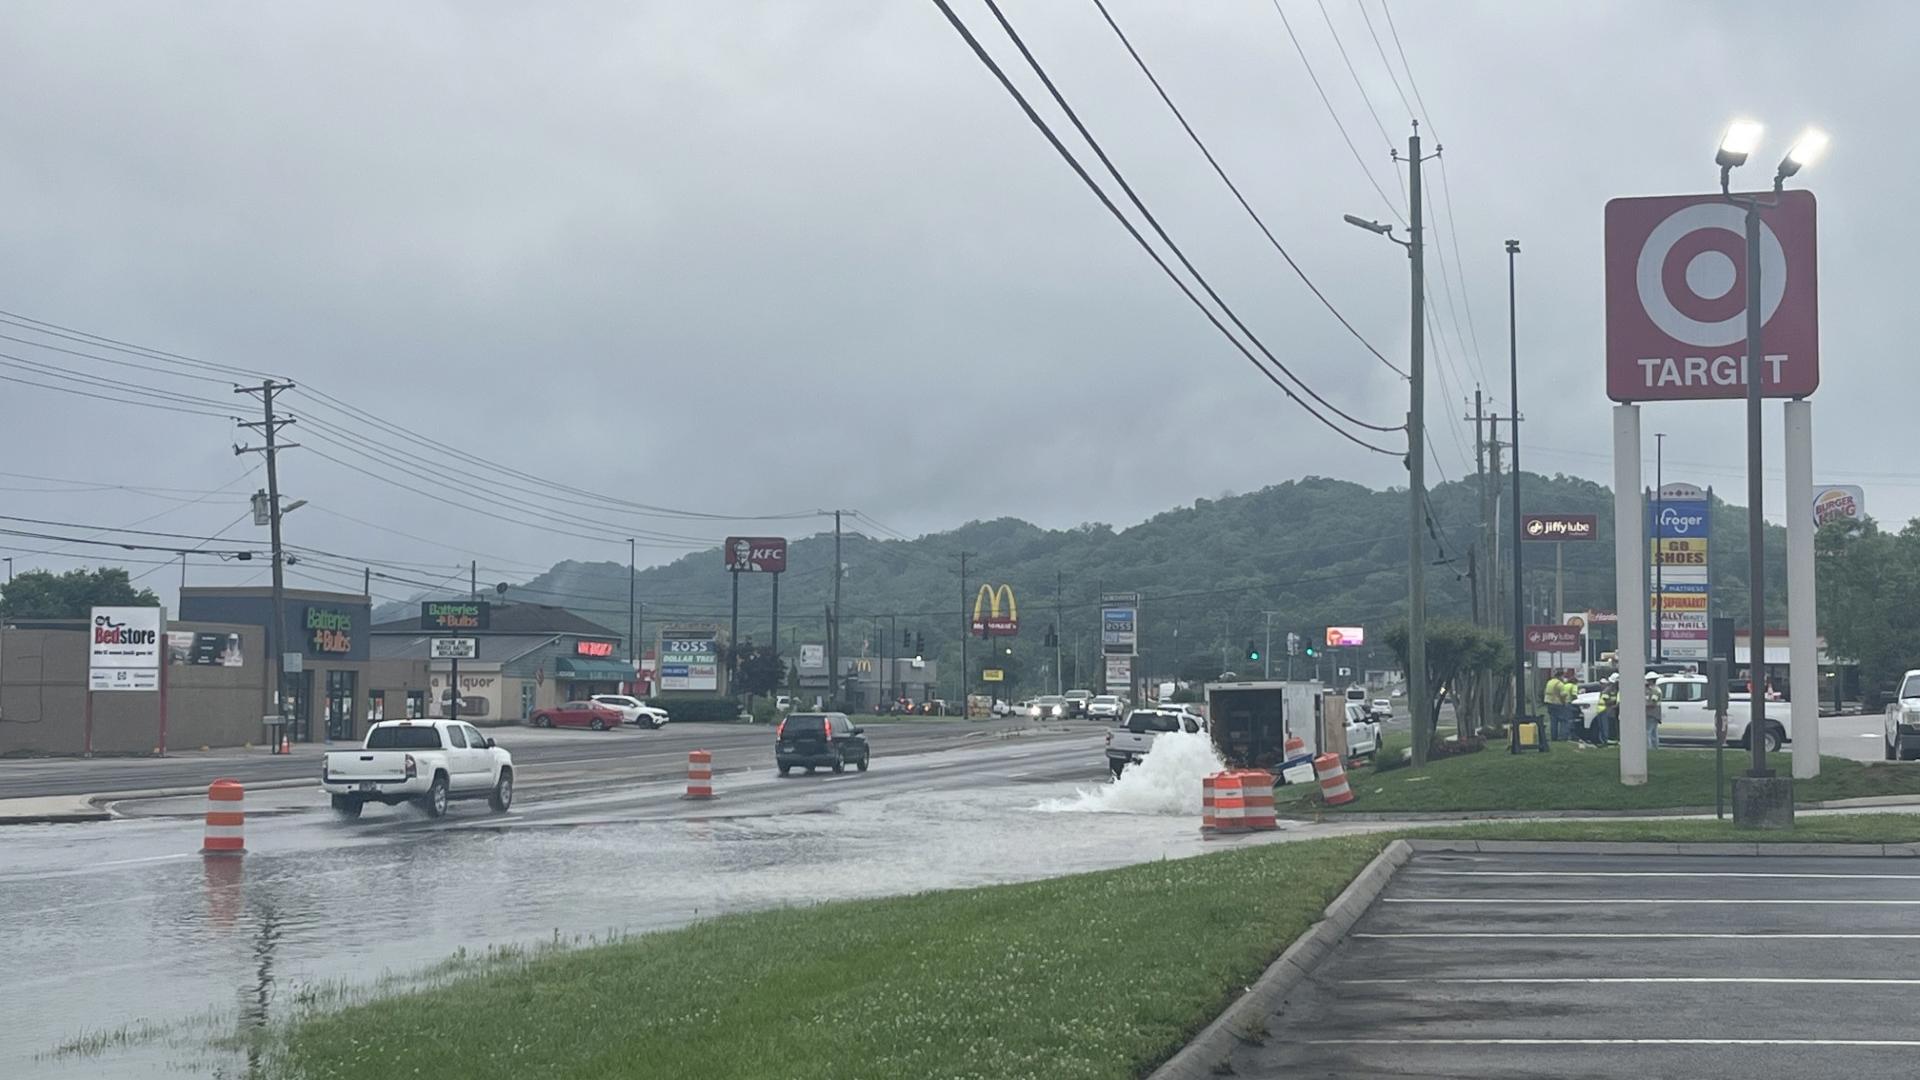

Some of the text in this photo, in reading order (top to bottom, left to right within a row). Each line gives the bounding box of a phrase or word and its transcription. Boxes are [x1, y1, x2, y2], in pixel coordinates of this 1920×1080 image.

[1816, 496, 1853, 514] BURGER
[1655, 507, 1703, 534] Kroger
[1544, 521, 1590, 533] jiffy lube
[1669, 541, 1689, 551] GB
[752, 549, 783, 559] KFC
[1655, 552, 1704, 563] SHOES
[429, 604, 479, 615] Batteries
[307, 607, 351, 630] Batteries
[1657, 612, 1684, 620] ALLY
[95, 628, 155, 645] Bedstore
[1542, 632, 1575, 642] jiffy lube
[671, 641, 708, 651] ROSS
